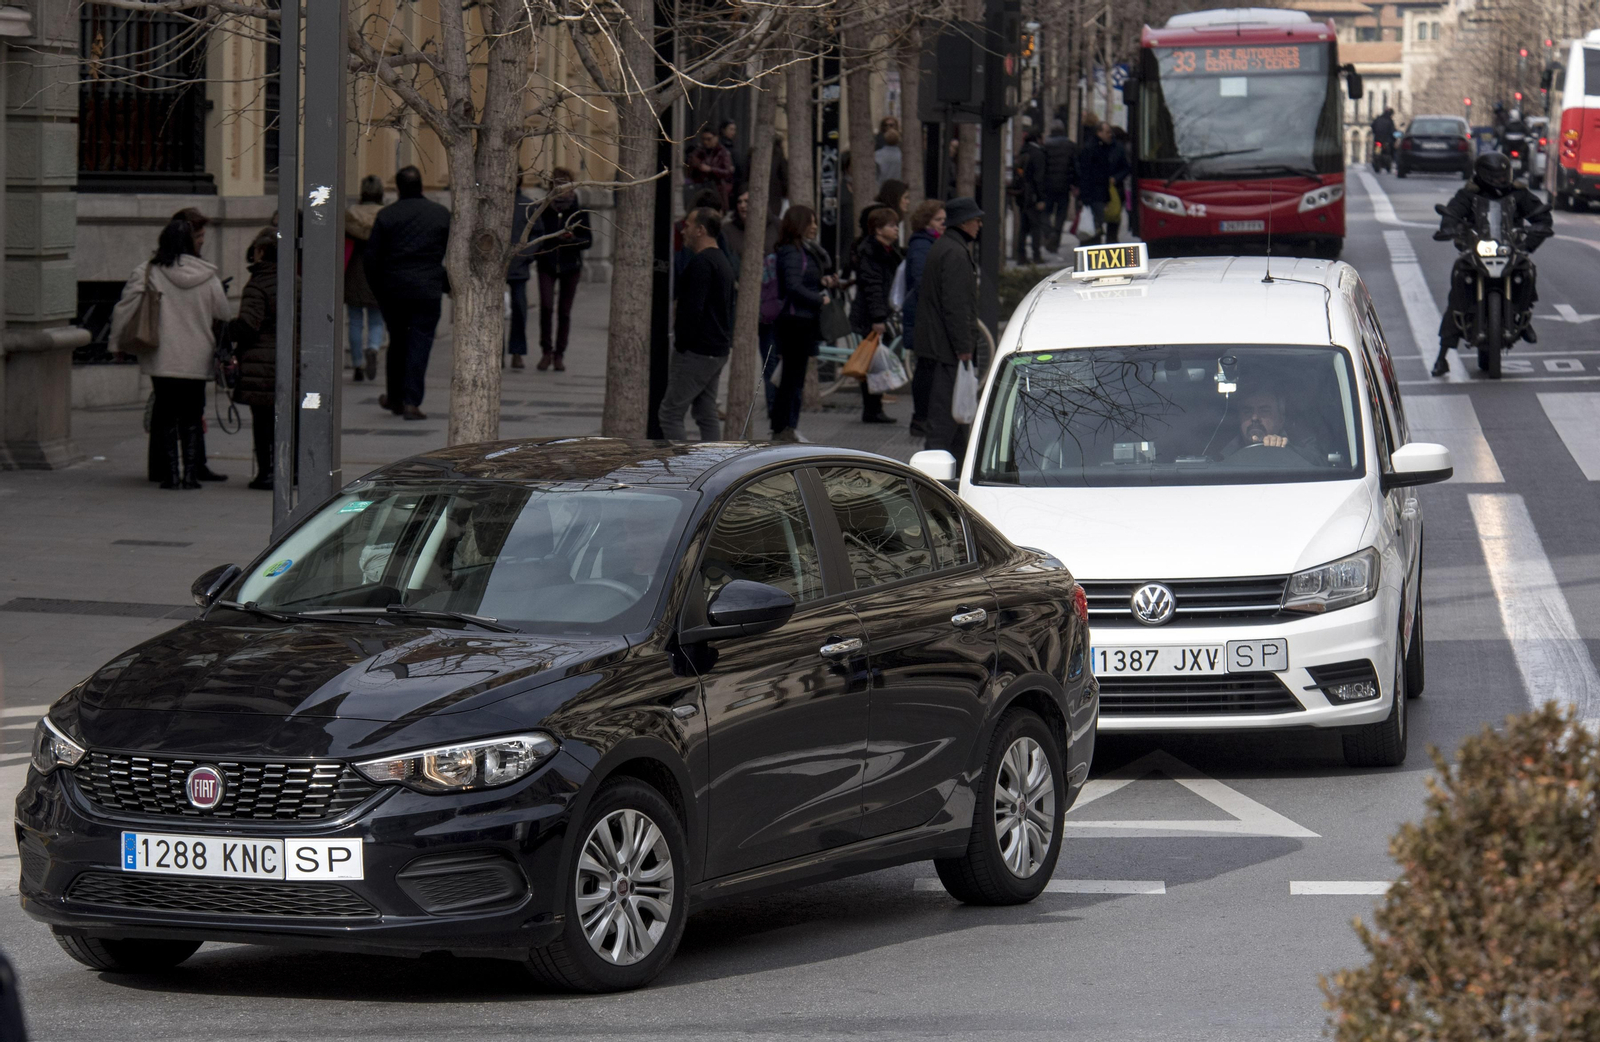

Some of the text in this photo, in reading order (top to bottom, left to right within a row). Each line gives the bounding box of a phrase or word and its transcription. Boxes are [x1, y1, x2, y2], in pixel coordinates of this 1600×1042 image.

[1173, 51, 1196, 72] 33
[1205, 57, 1300, 71] CENTRO CENES
[1187, 204, 1207, 217] 42
[1087, 248, 1126, 270] TAXI
[1100, 648, 1219, 672] 1387 JXV
[1235, 643, 1279, 668] SP
[194, 778, 215, 799] FIAT
[127, 838, 278, 874] E 1288 KNC
[295, 846, 352, 873] SP
